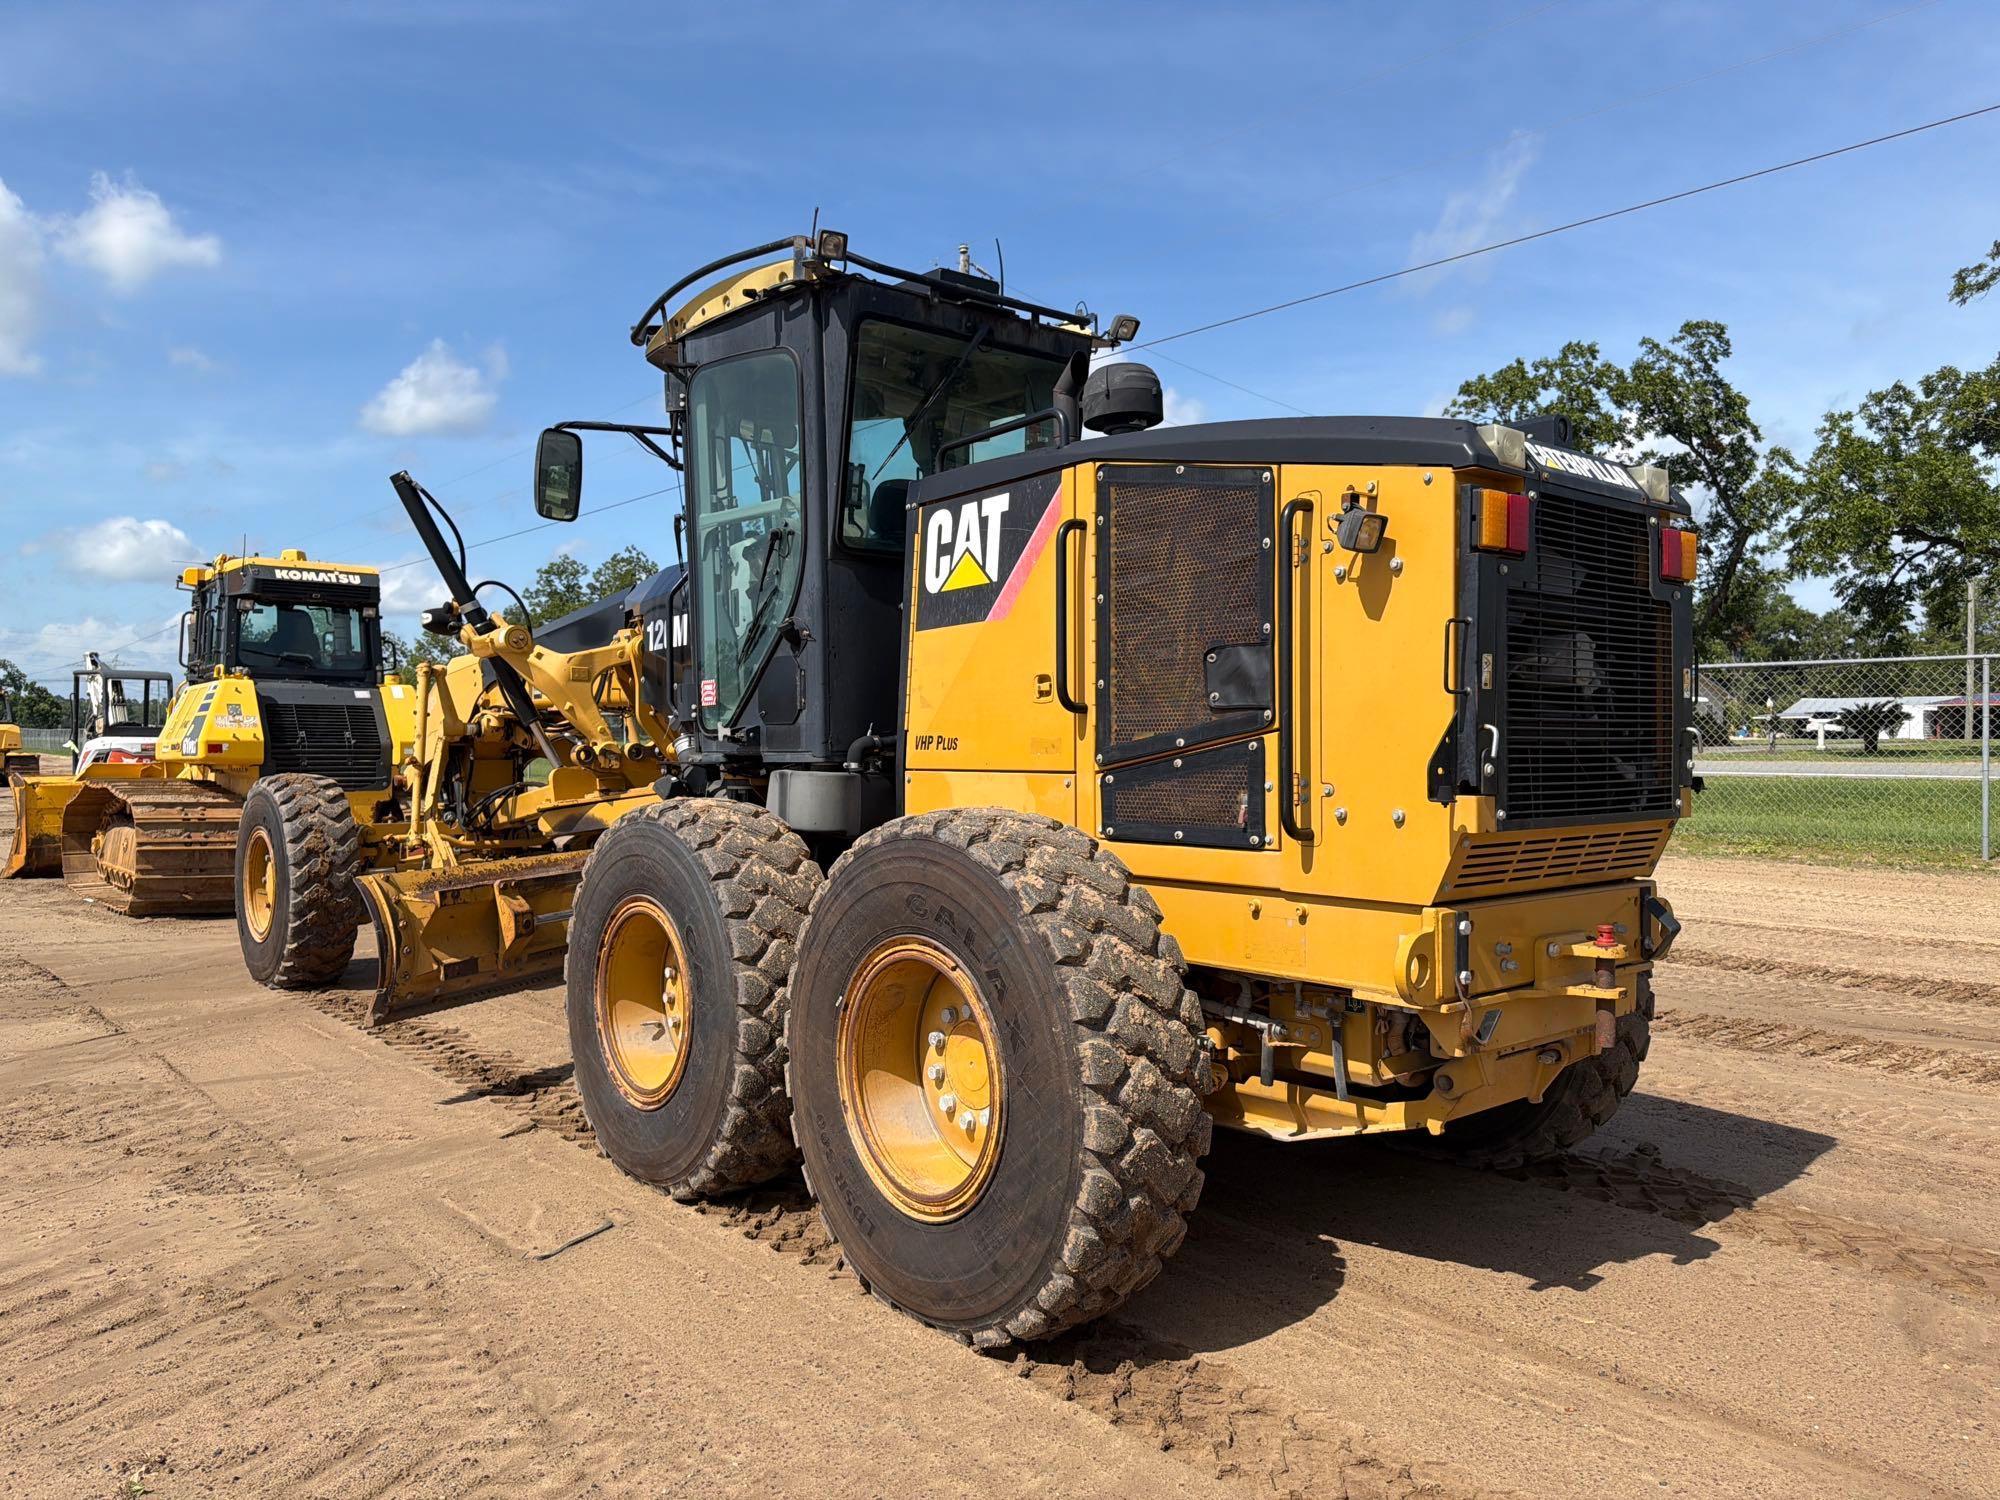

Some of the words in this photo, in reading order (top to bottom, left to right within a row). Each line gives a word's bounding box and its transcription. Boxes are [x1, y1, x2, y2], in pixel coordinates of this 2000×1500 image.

[1523, 441, 1639, 490] CATERPILLAR
[925, 492, 1010, 594] CAT
[274, 569, 361, 585] KOMATSU
[915, 735, 934, 751] VHP
[906, 892, 1042, 1108] GALAXY
